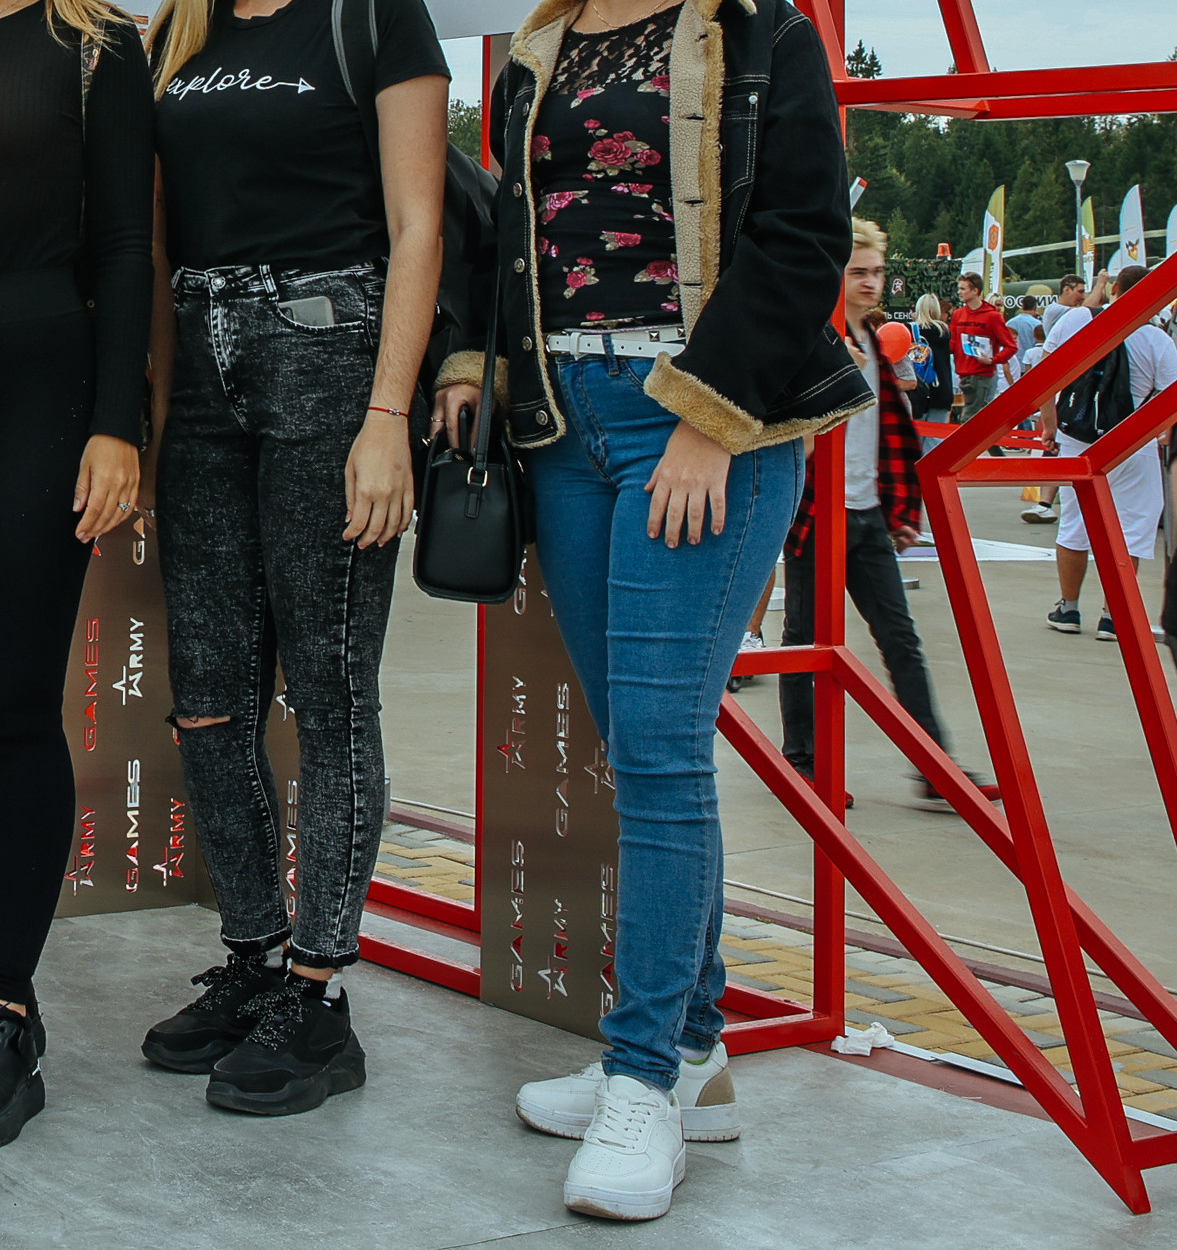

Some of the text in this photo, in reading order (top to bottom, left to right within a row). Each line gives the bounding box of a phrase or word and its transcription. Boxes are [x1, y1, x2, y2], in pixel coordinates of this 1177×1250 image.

[166, 66, 279, 101] explore
[1003, 294, 1059, 309] ОСИИ
[83, 617, 101, 752] GAMES
[126, 757, 142, 894] GAMES
[555, 681, 570, 838] GAMES
[284, 778, 299, 919] GAMES
[510, 838, 525, 993] GAMES
[599, 861, 616, 1019] GAMES
